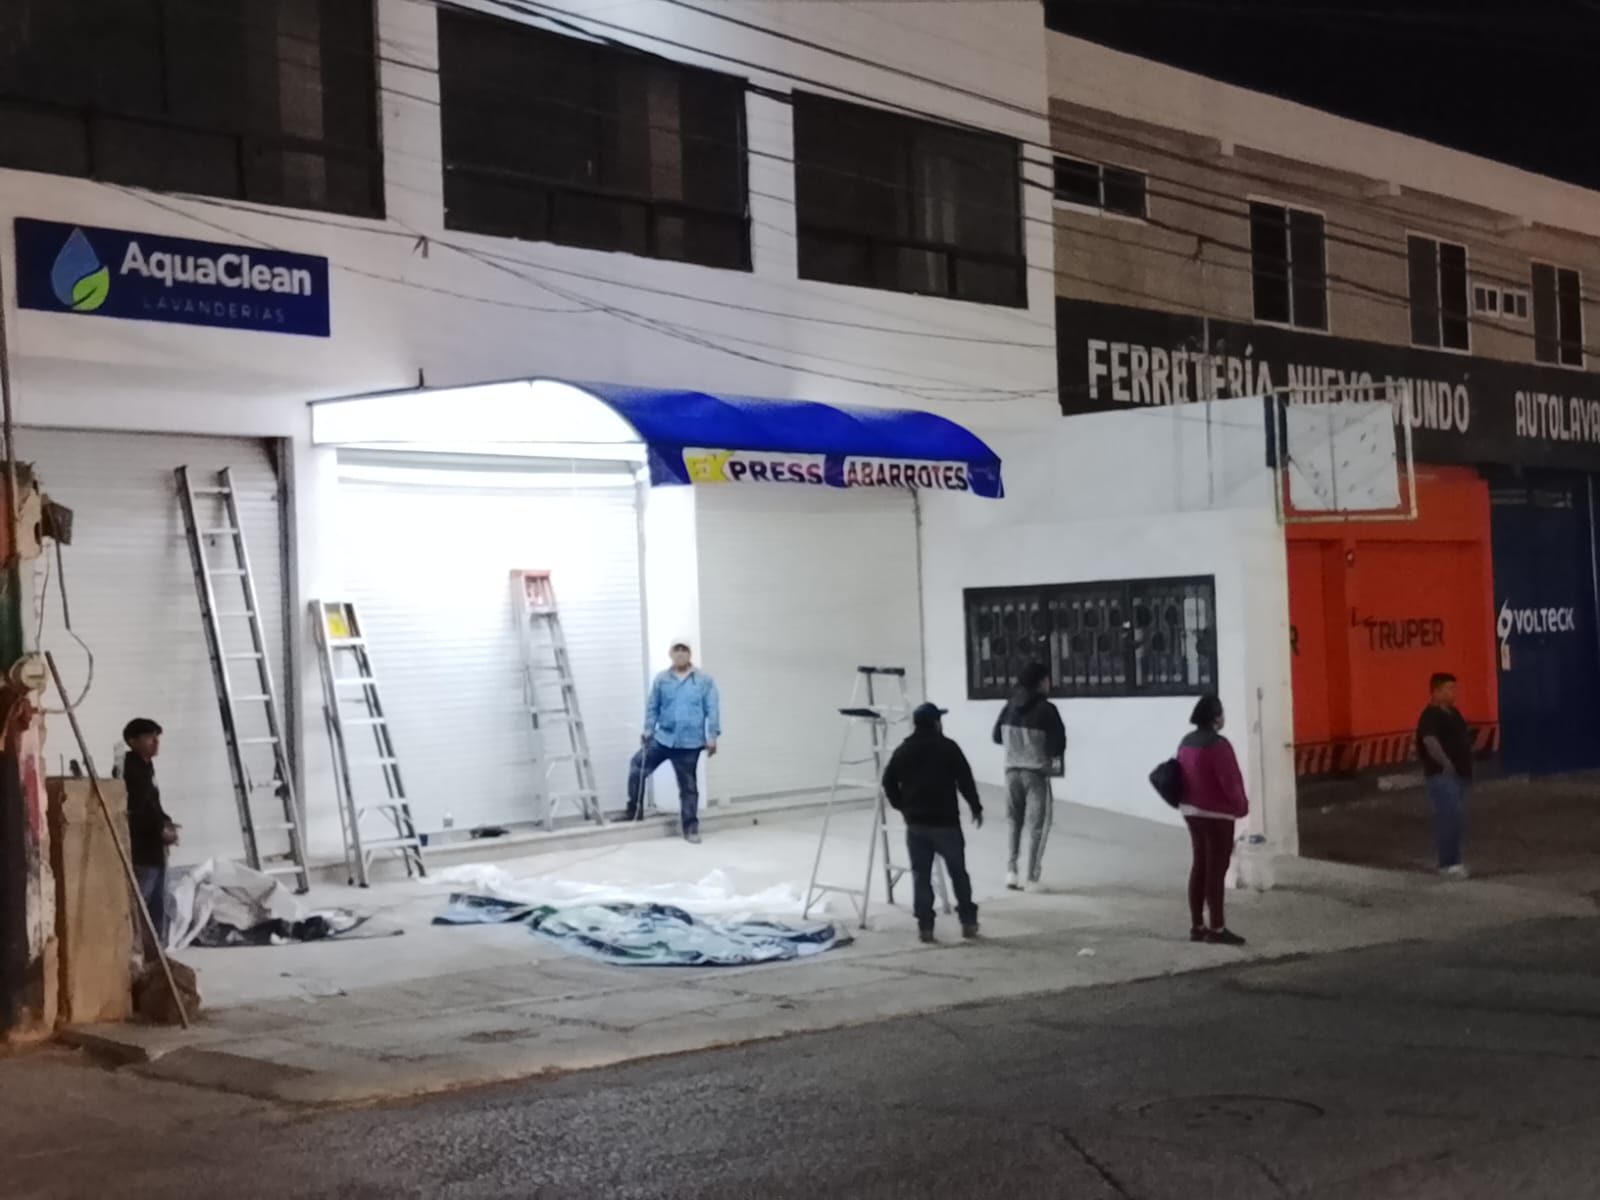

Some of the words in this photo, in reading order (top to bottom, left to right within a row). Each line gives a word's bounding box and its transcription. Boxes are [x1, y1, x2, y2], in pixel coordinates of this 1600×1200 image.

[120, 242, 311, 296] AquaClean
[1087, 338, 1273, 405] FERRETERÍA
[847, 461, 969, 491] ABARROTES
[1363, 617, 1446, 651] TRUPER
